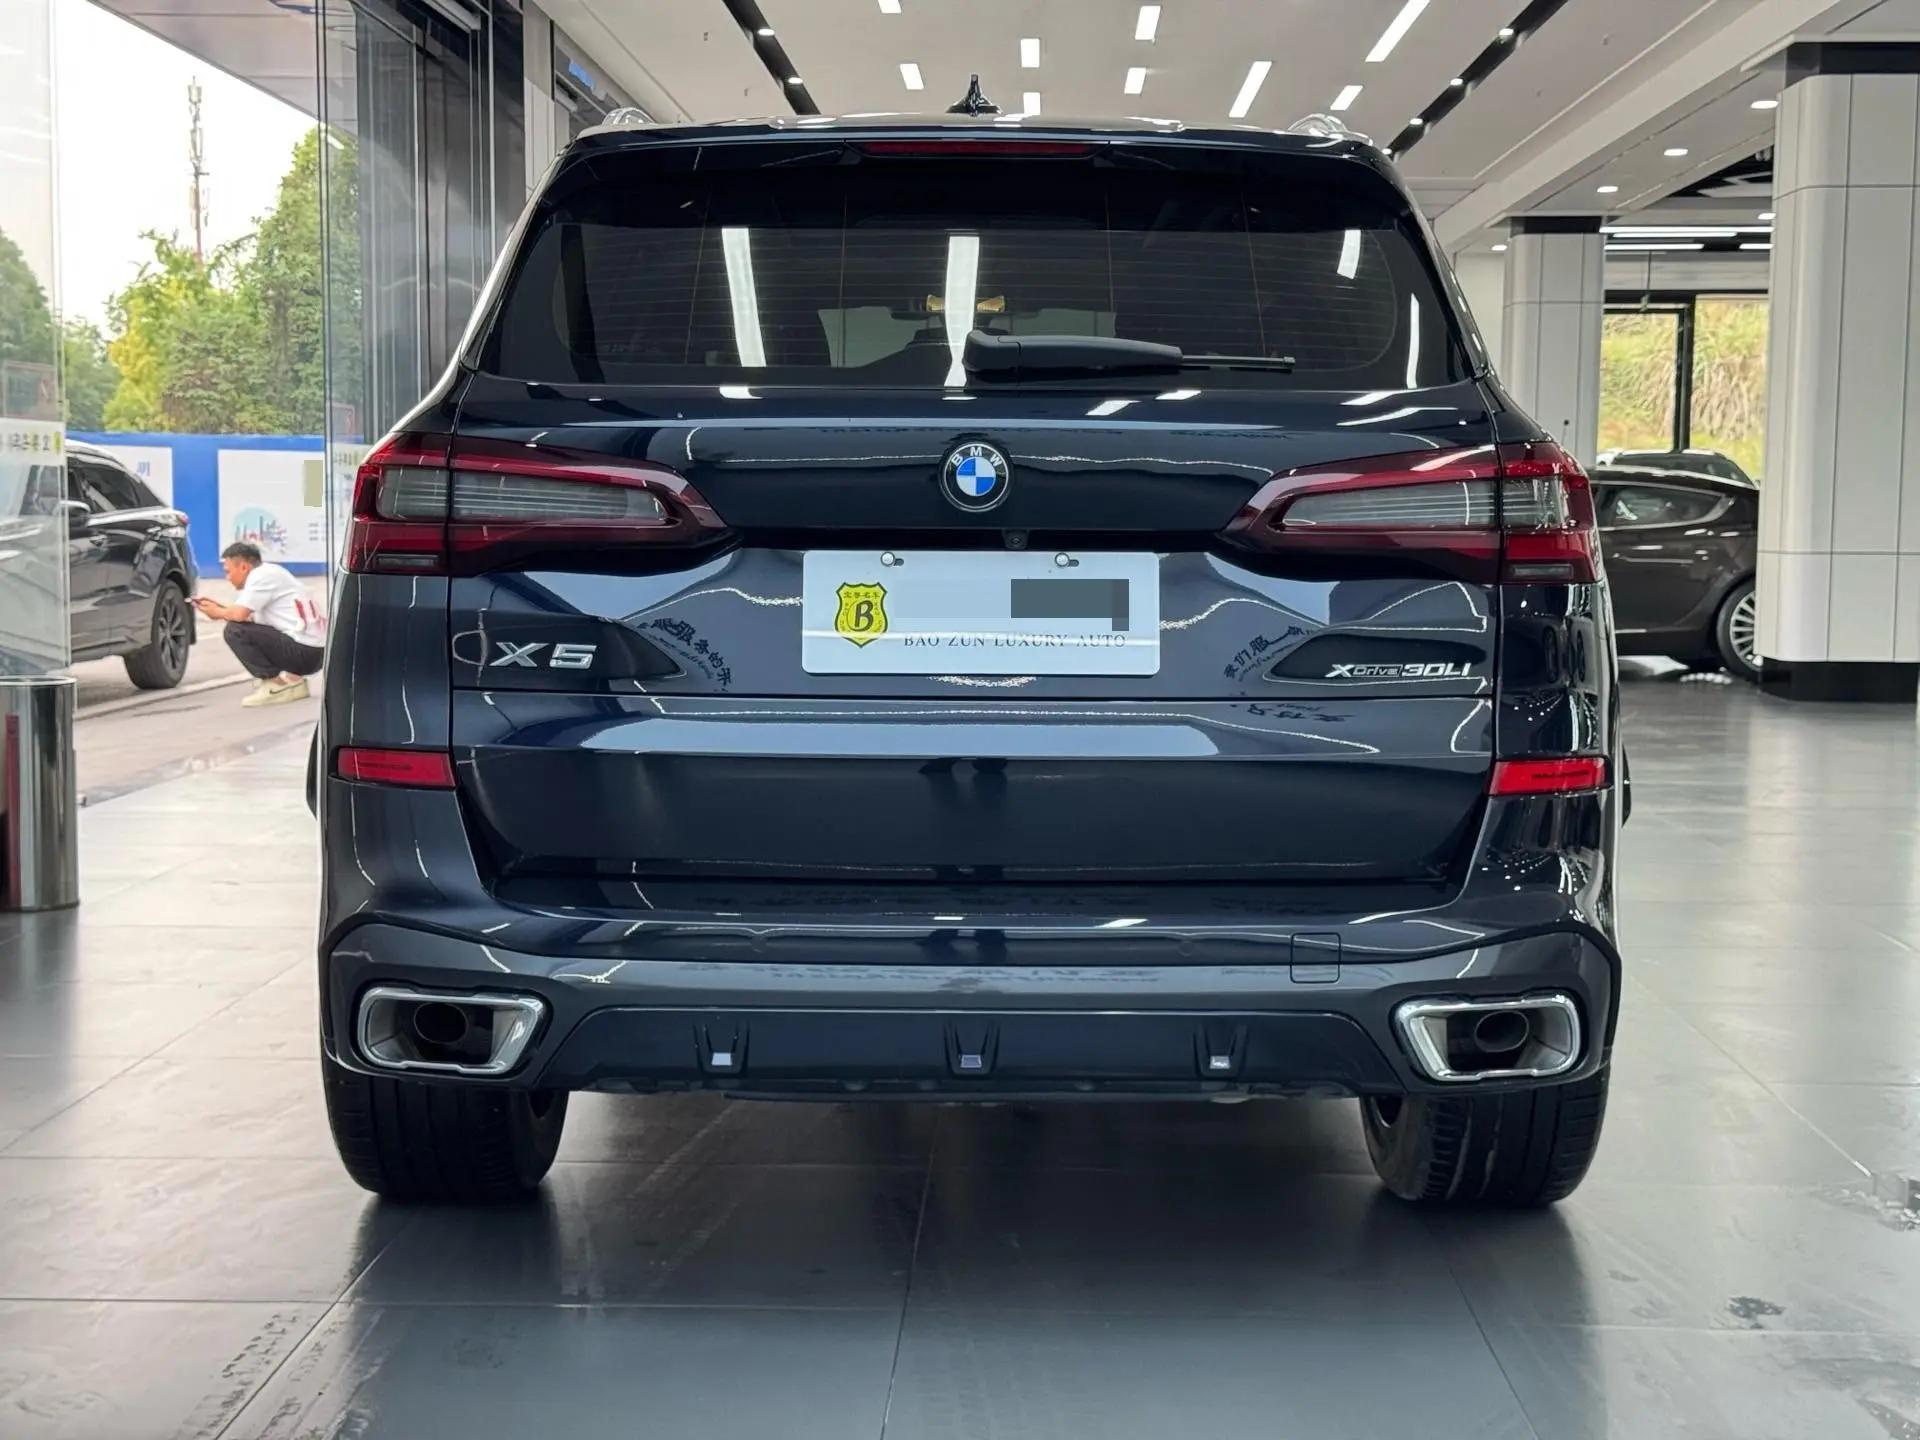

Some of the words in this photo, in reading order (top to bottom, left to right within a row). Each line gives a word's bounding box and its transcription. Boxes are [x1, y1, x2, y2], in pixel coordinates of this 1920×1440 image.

[951, 446, 1003, 467] BMW
[904, 634, 940, 648] BAO
[948, 634, 986, 648] ZUN
[994, 634, 1068, 648] LUXURY
[1076, 634, 1127, 648] AUTO
[489, 641, 598, 670] X5
